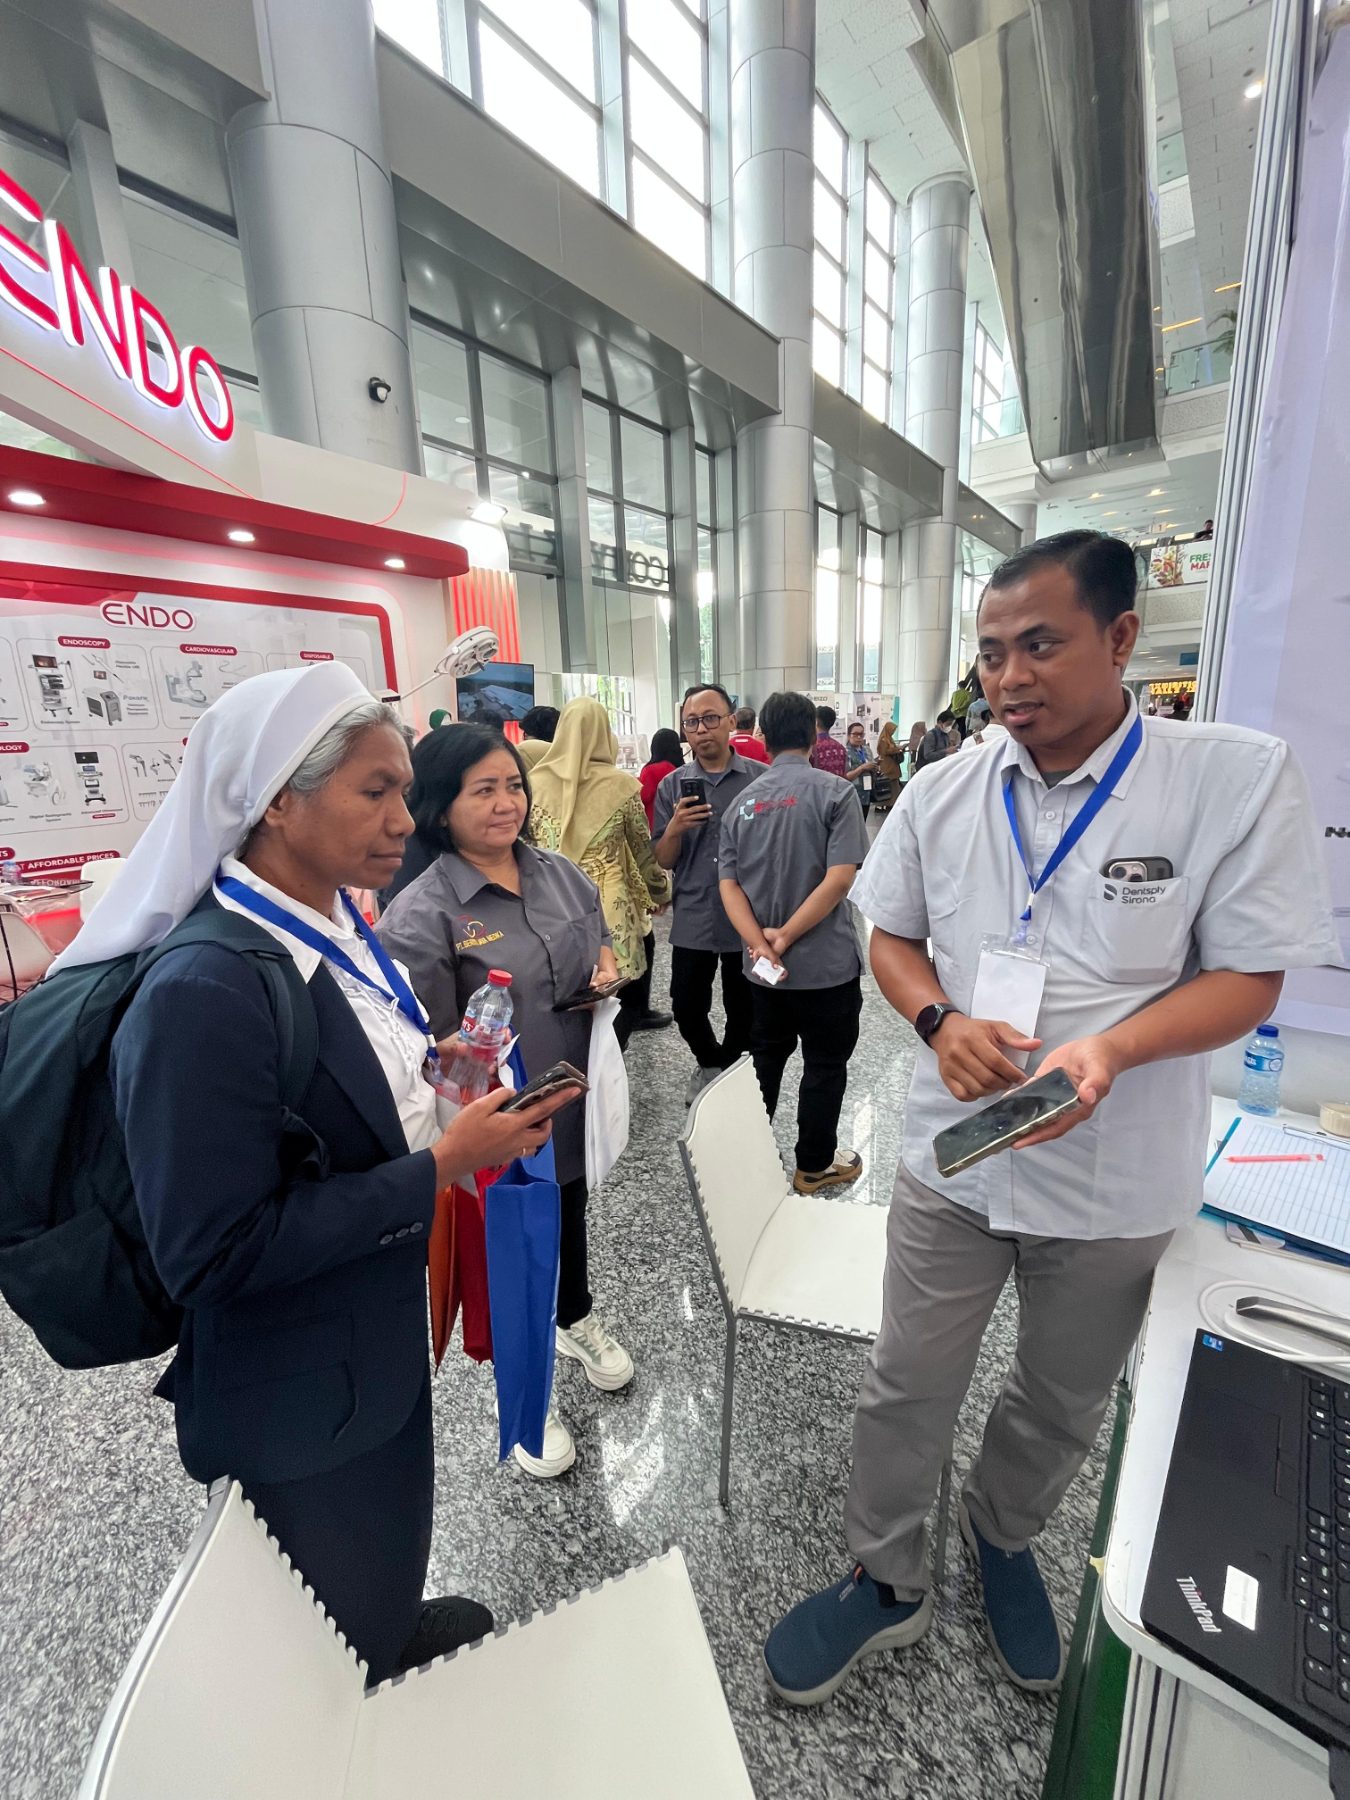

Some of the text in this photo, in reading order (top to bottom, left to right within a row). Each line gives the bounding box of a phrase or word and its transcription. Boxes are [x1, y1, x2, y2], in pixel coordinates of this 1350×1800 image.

[102, 602, 194, 630] ENDO
[62, 639, 107, 647] ENDOSCOPY
[184, 646, 235, 654] CARDIOVASCULAR
[27, 856, 85, 870] AFFORDABLE
[87, 852, 115, 861] PRICES
[1122, 886, 1167, 896] Dentsply
[1121, 895, 1156, 904] Sirona
[1176, 1576, 1222, 1632] ThinkPad
